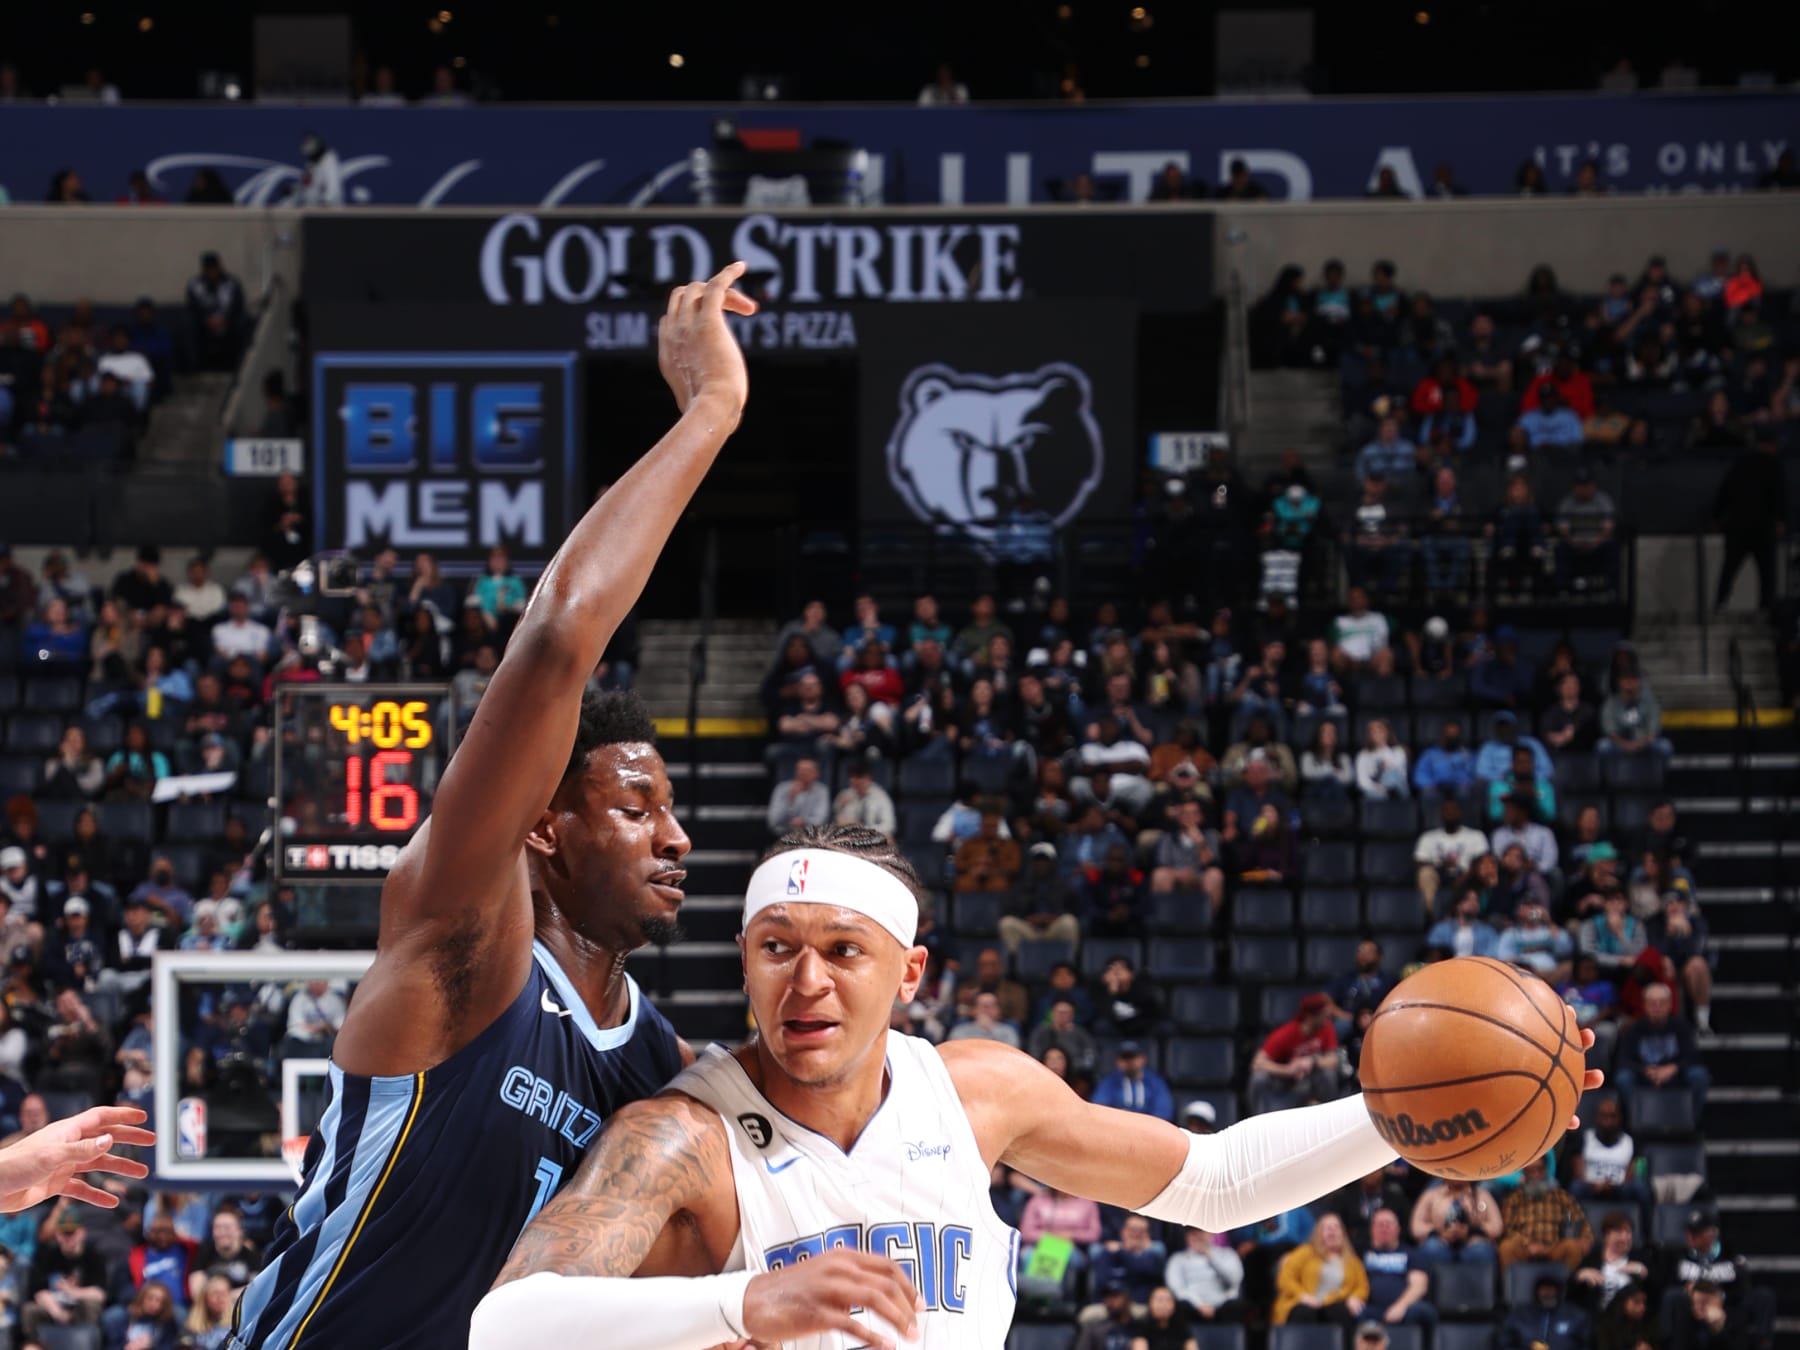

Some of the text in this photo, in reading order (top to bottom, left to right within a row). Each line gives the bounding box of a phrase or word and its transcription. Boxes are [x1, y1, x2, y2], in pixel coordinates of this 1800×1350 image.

[1656, 140, 1788, 176] ONLY
[731, 213, 1023, 302] STRIKE
[585, 312, 649, 349] SLIM
[783, 311, 857, 347] PIZZA
[344, 382, 544, 472] BIG
[249, 444, 289, 469] 101
[345, 481, 543, 547] MEM
[329, 701, 432, 749] 4:05
[346, 750, 418, 831] 16
[328, 844, 404, 870] TISS
[500, 1066, 602, 1148] GRIZZ
[740, 1117, 767, 1146] 6
